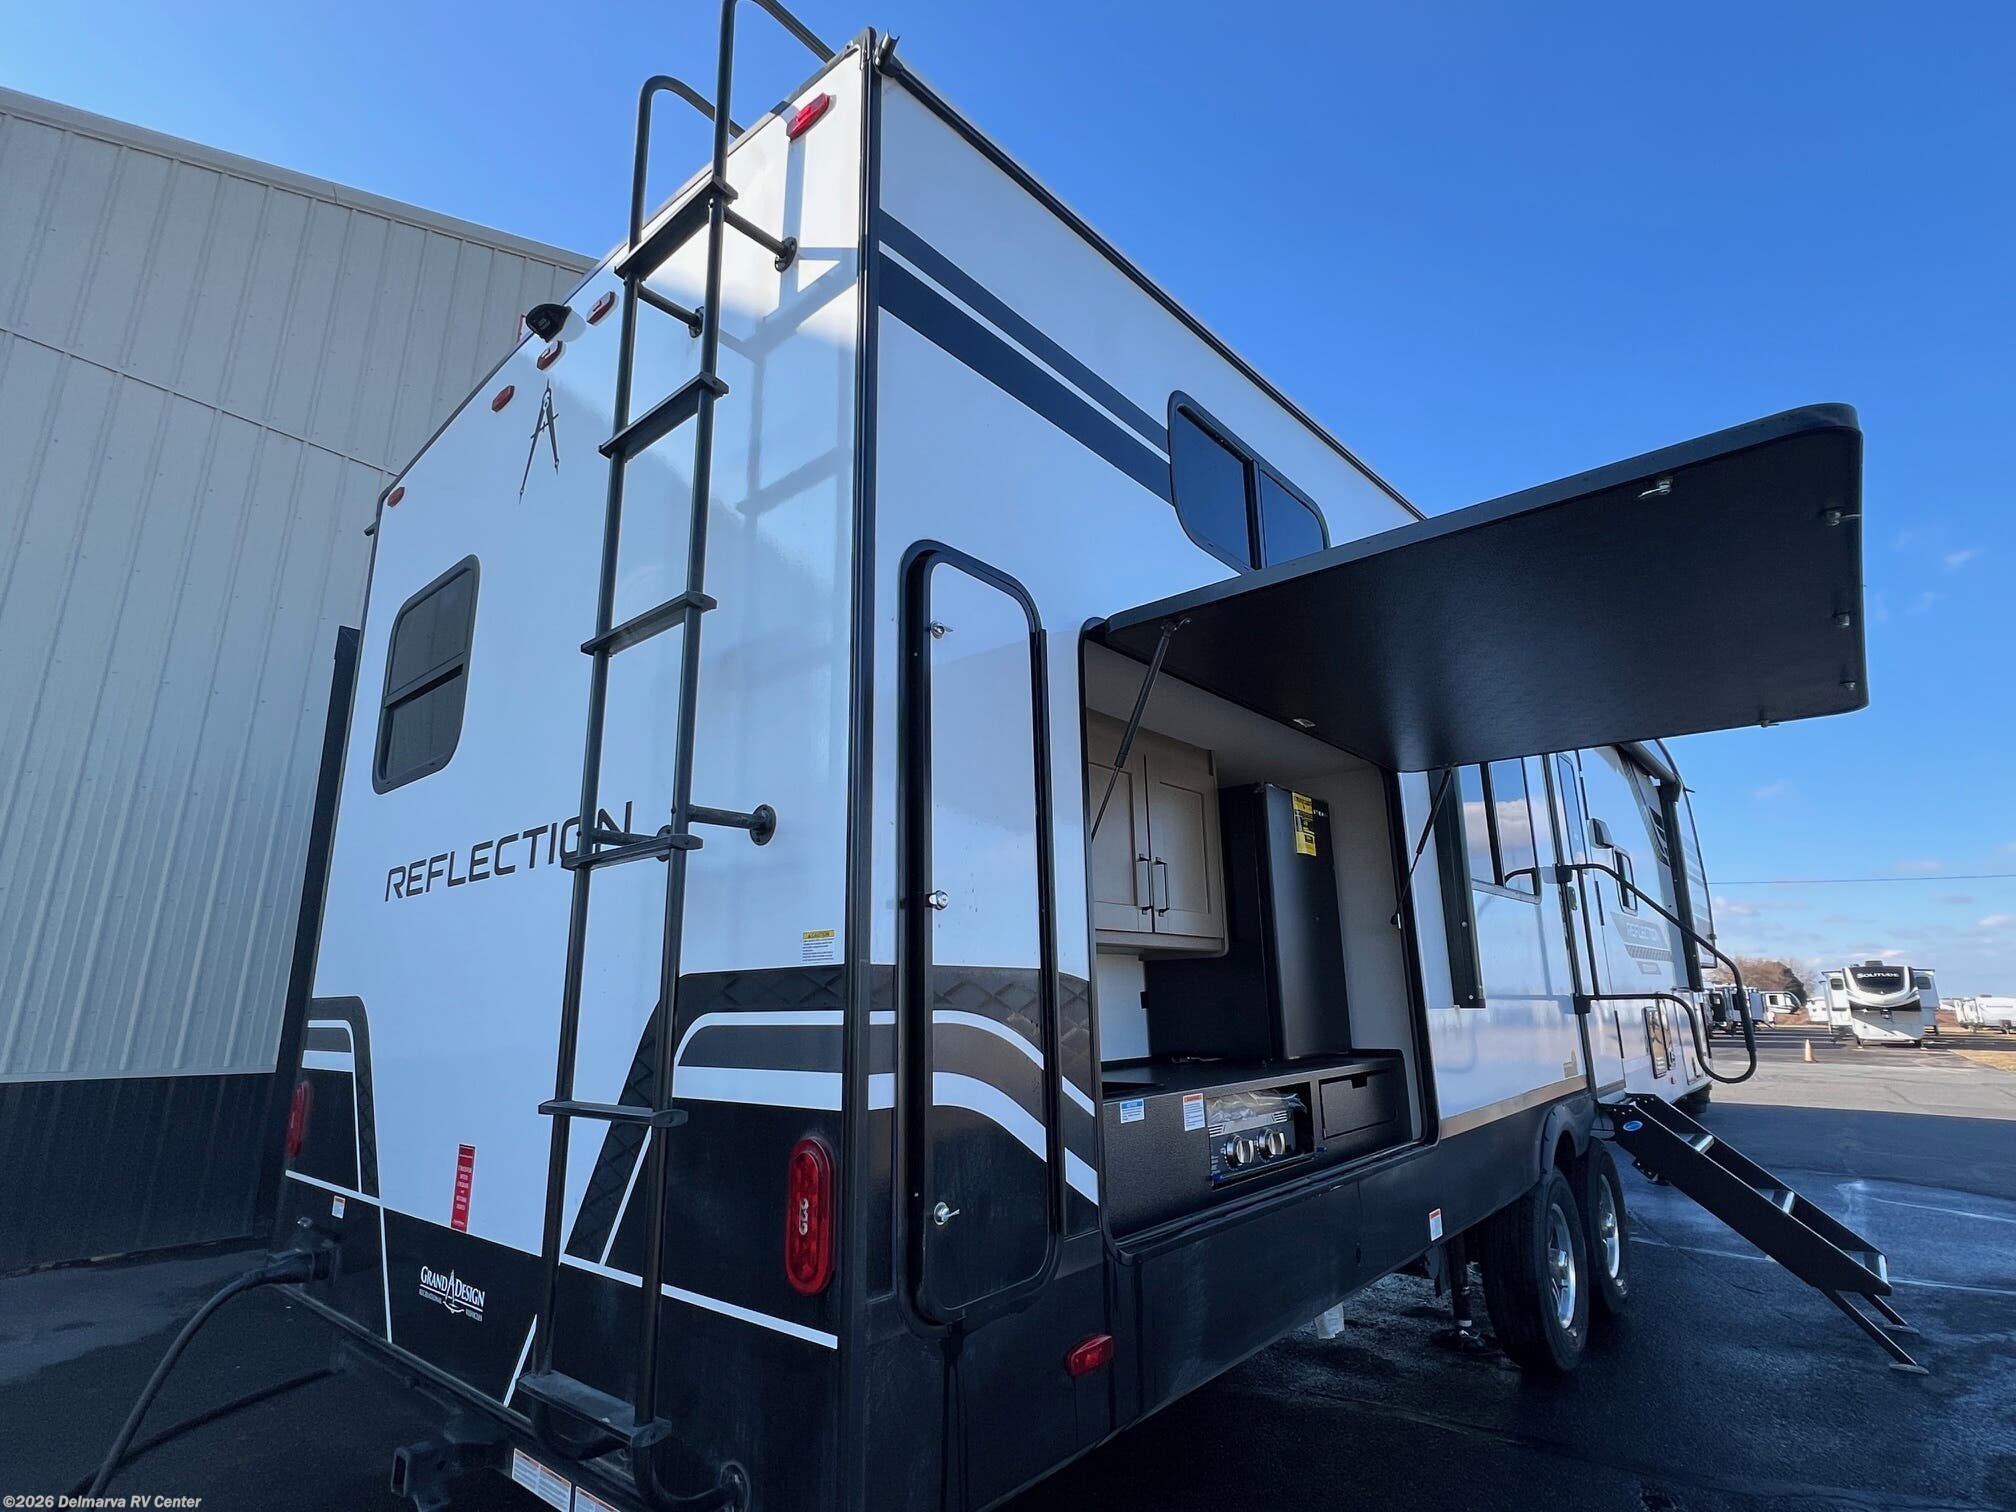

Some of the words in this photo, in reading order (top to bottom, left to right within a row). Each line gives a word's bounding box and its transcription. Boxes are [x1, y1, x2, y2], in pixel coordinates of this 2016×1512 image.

[384, 800, 633, 902] REFLECTION
[420, 1265, 448, 1292] GRAND
[455, 1278, 486, 1308] DESIGN
